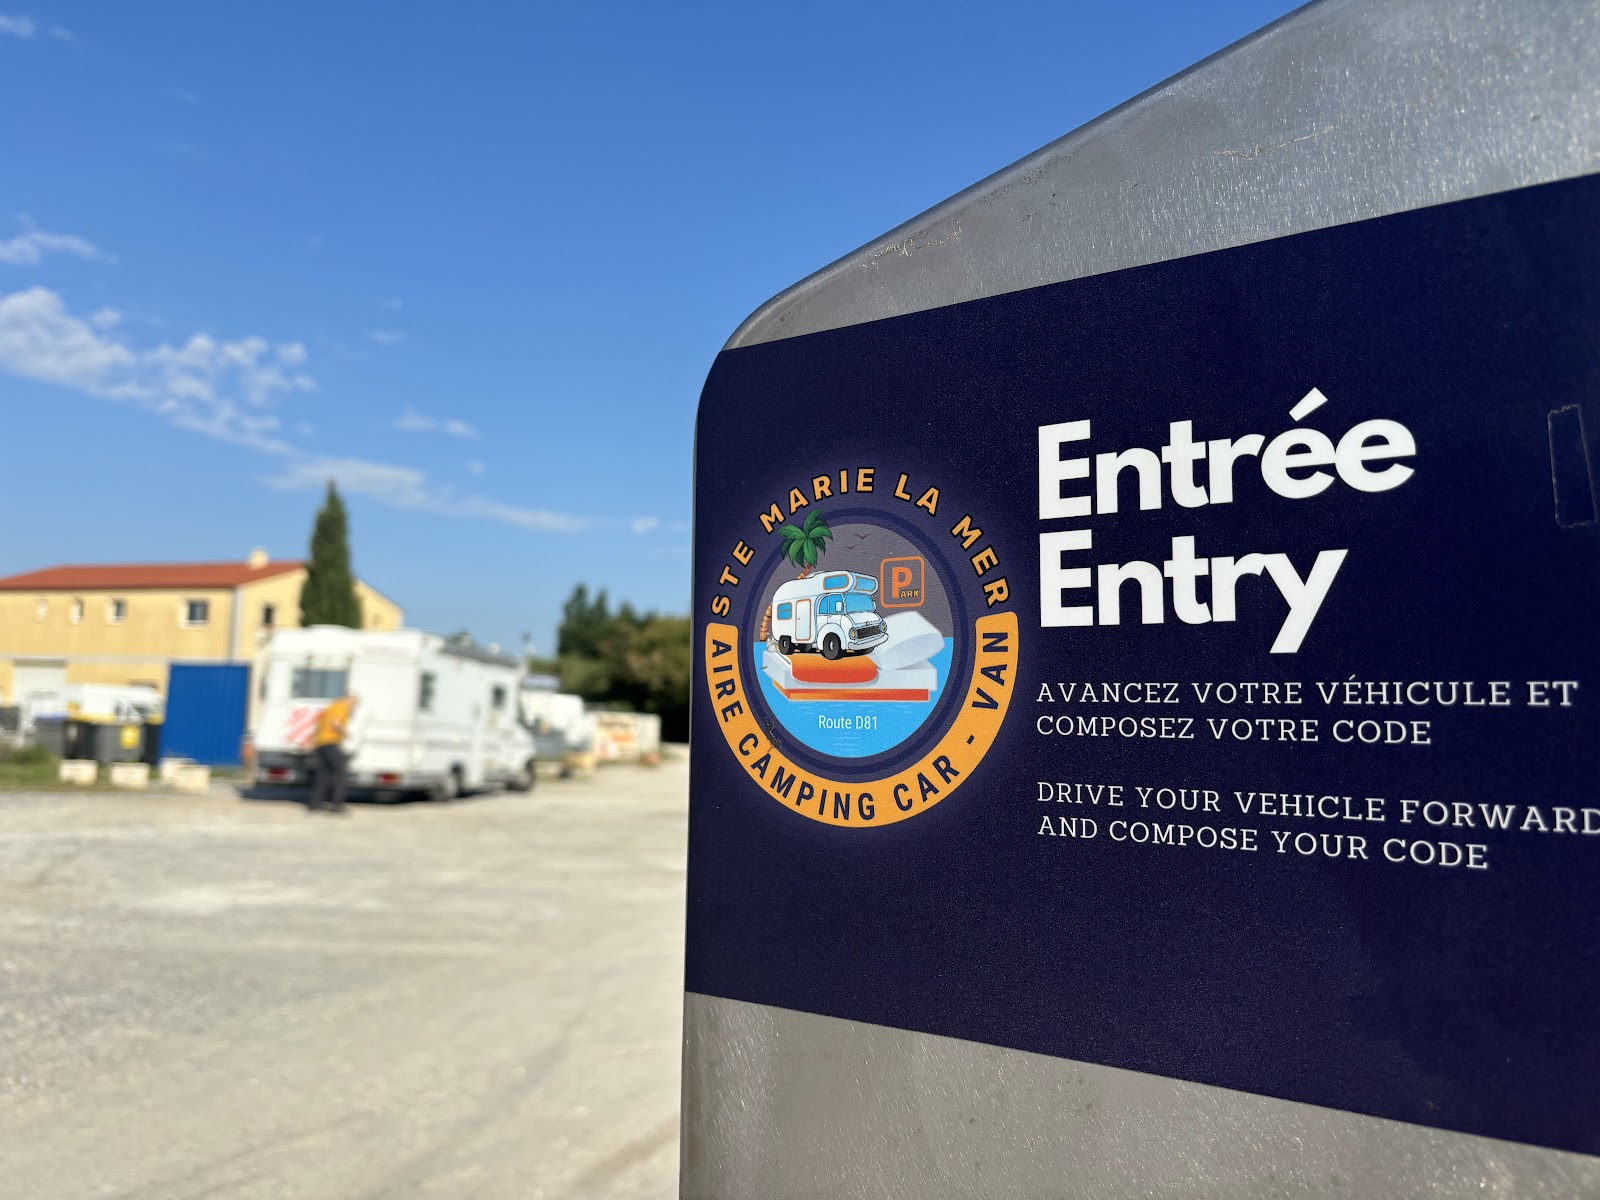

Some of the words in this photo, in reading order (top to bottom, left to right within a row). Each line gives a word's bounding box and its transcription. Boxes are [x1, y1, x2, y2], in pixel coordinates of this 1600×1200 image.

[1038, 386, 1417, 520] Entrée
[711, 540, 755, 617] STE
[759, 467, 876, 534] MARIE
[894, 473, 941, 515] LA
[951, 515, 1010, 607] MER
[1039, 529, 1349, 654] Entry
[1036, 682, 1180, 704] AVANCEZ
[1192, 682, 1303, 704] VOTRE
[1315, 674, 1511, 706] VÉHICULE
[1526, 681, 1579, 706] ET
[712, 638, 744, 723] AIRE
[738, 732, 876, 821] CAMPING
[893, 754, 960, 811] CAR
[973, 631, 1009, 711] VAN
[818, 714, 852, 729] Route
[855, 715, 877, 730] D81
[1036, 715, 1195, 739] COMPOSEZ
[1206, 718, 1319, 742] VOTRE
[1332, 719, 1432, 745] CODE
[1037, 781, 1124, 807] DRIVE
[1134, 786, 1221, 812] YOUR
[1233, 791, 1386, 822] VEHICLE
[1399, 799, 1600, 834] FORWARD
[1037, 815, 1098, 839] AND
[1109, 820, 1258, 851] COMPOSE
[1270, 830, 1369, 860] YOUR
[1383, 838, 1489, 870] CODE
